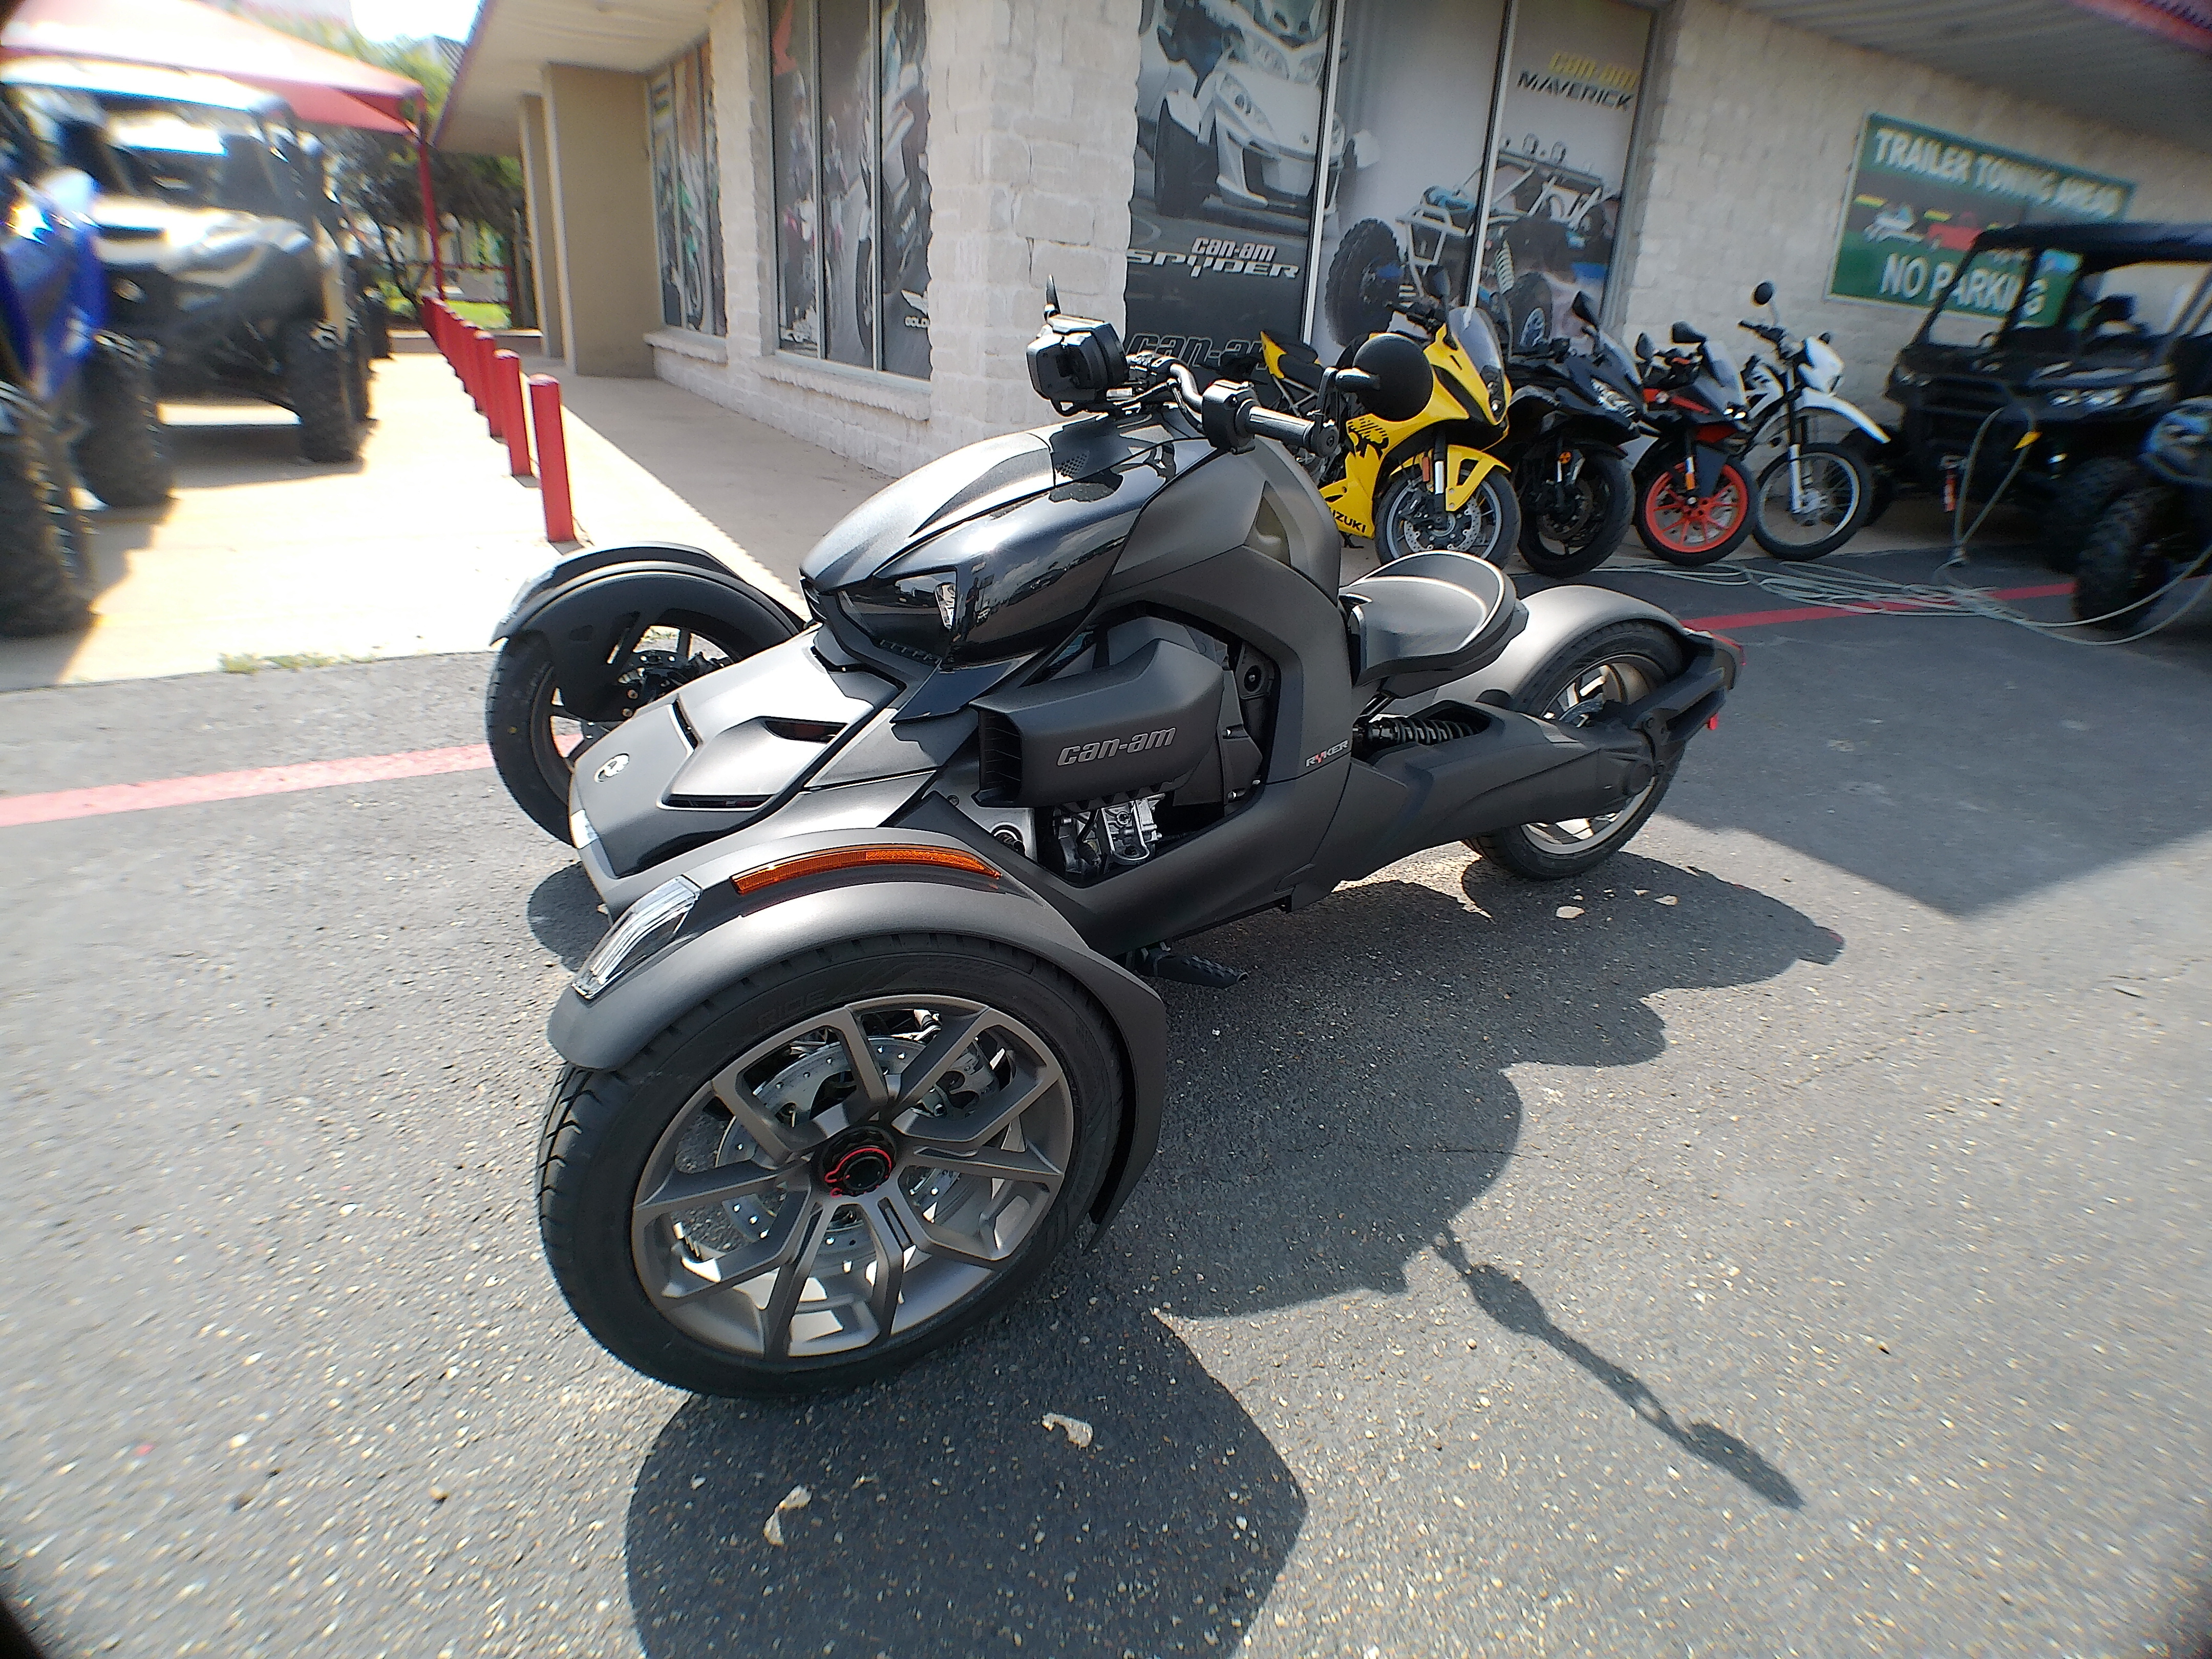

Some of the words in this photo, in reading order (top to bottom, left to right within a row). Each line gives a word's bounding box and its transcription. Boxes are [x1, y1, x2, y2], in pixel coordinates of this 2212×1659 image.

[1517, 68, 1633, 111] MAVERICK
[1874, 127, 1975, 184] TRAILER
[1126, 248, 1300, 279] SPYDER
[1191, 237, 1276, 262] can-am
[1879, 253, 1927, 299] NO
[1926, 261, 2048, 317] PARKIG
[1057, 727, 1176, 766] can-am
[1305, 739, 1349, 768] RYKER
